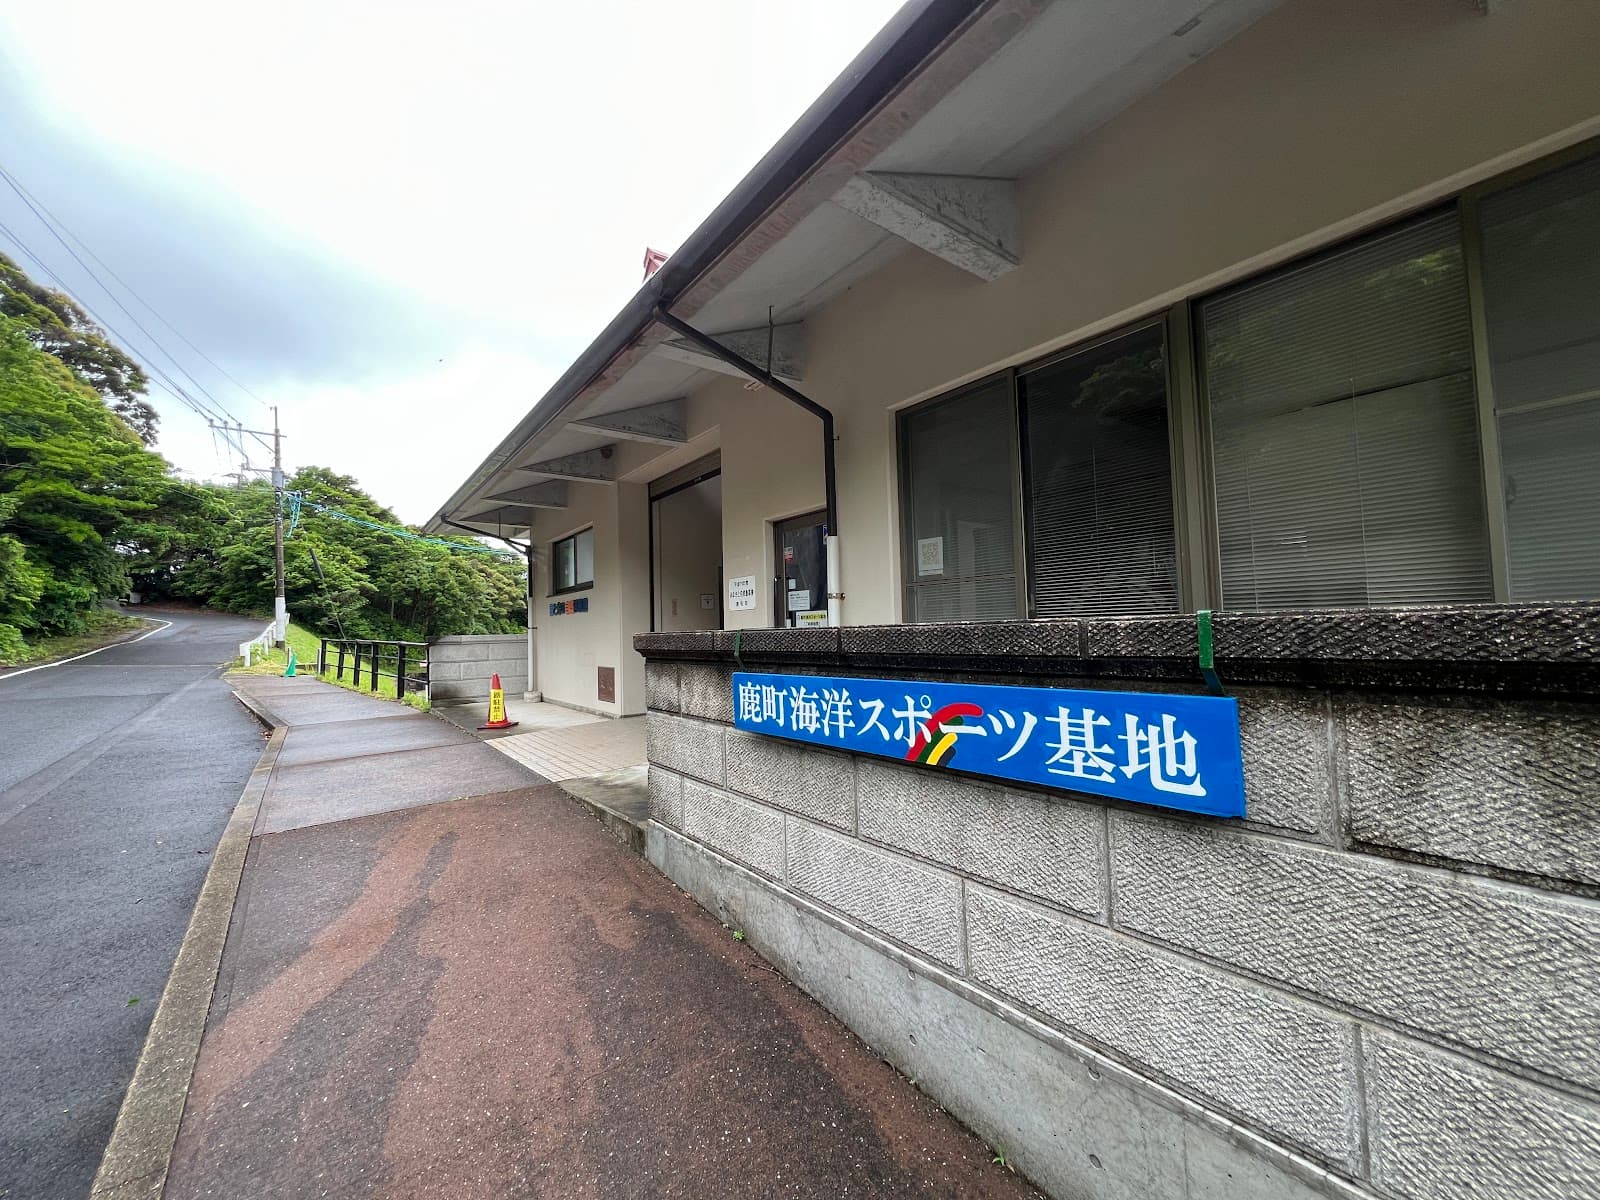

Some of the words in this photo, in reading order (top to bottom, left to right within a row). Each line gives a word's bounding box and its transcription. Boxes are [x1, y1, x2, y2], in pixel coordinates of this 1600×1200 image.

[738, 683, 1207, 797] 鹿町海洋スポーツ基地
